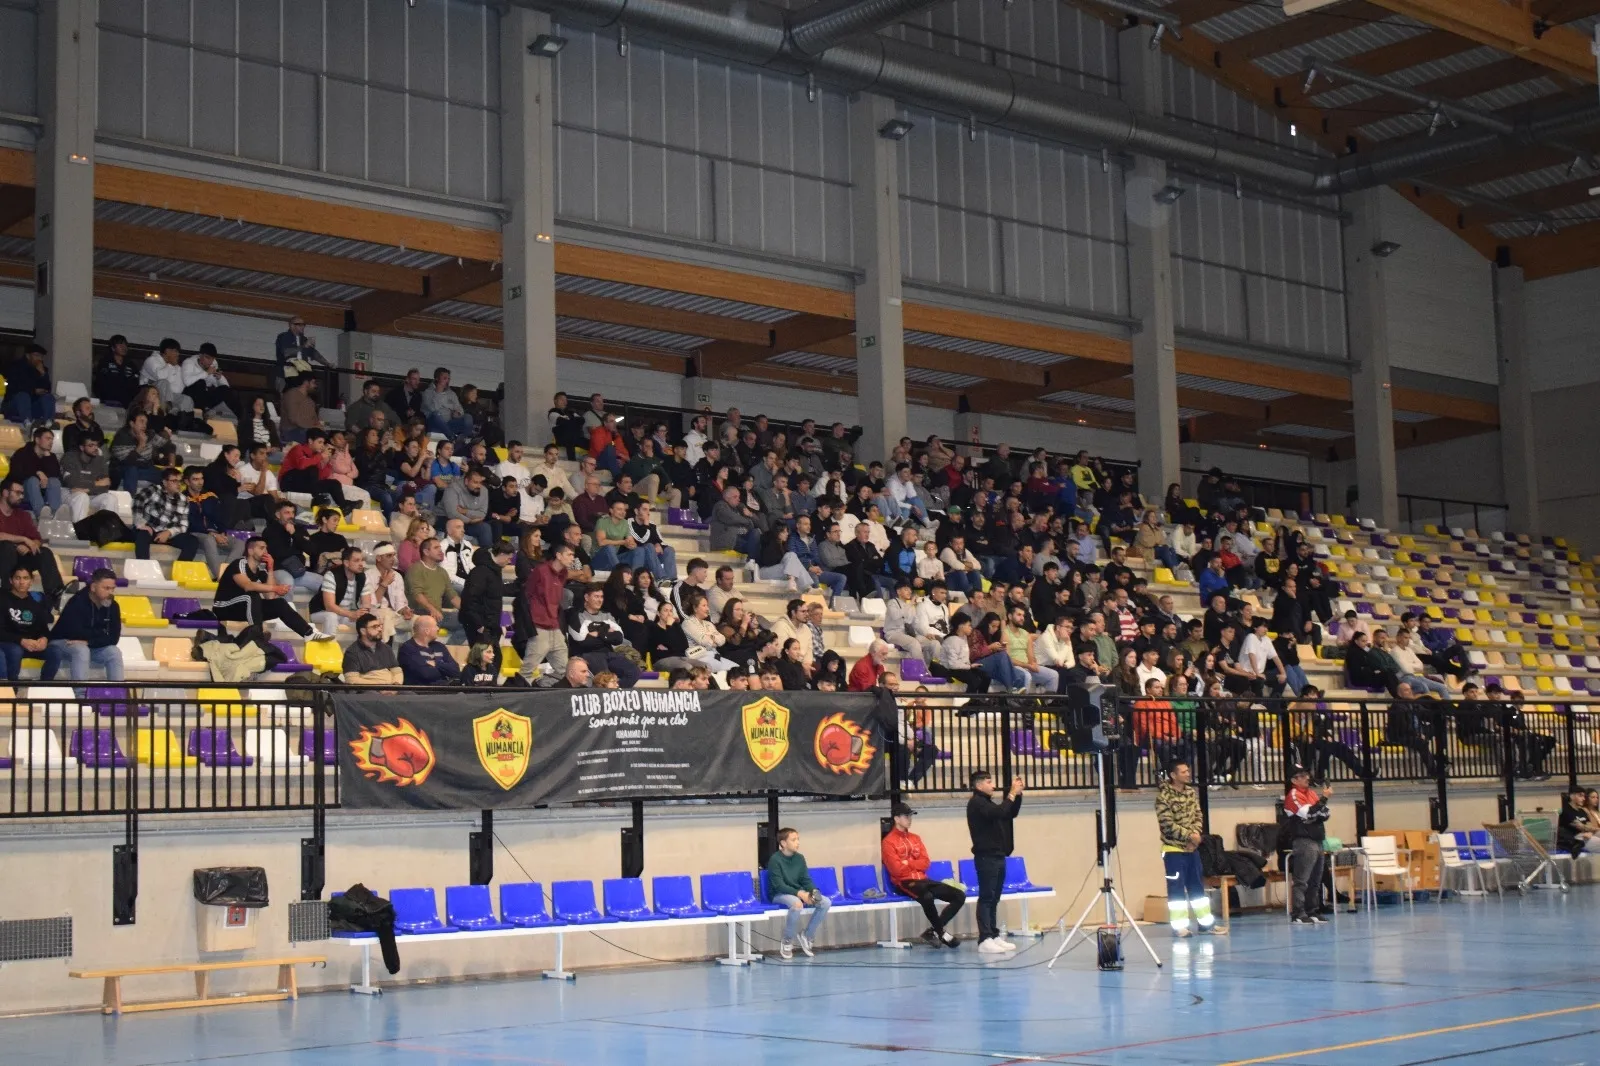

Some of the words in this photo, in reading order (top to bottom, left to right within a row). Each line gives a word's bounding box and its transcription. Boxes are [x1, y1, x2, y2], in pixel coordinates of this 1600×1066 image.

[571, 694, 602, 717] CLUB
[602, 689, 641, 714] BOXEO
[642, 690, 701, 712] NUMANCIA
[619, 712, 640, 726] más
[640, 715, 656, 730] que
[657, 716, 669, 726] un
[669, 712, 689, 726] club
[751, 727, 785, 740] NUMANCIA
[486, 741, 524, 757] NUMANCIA
